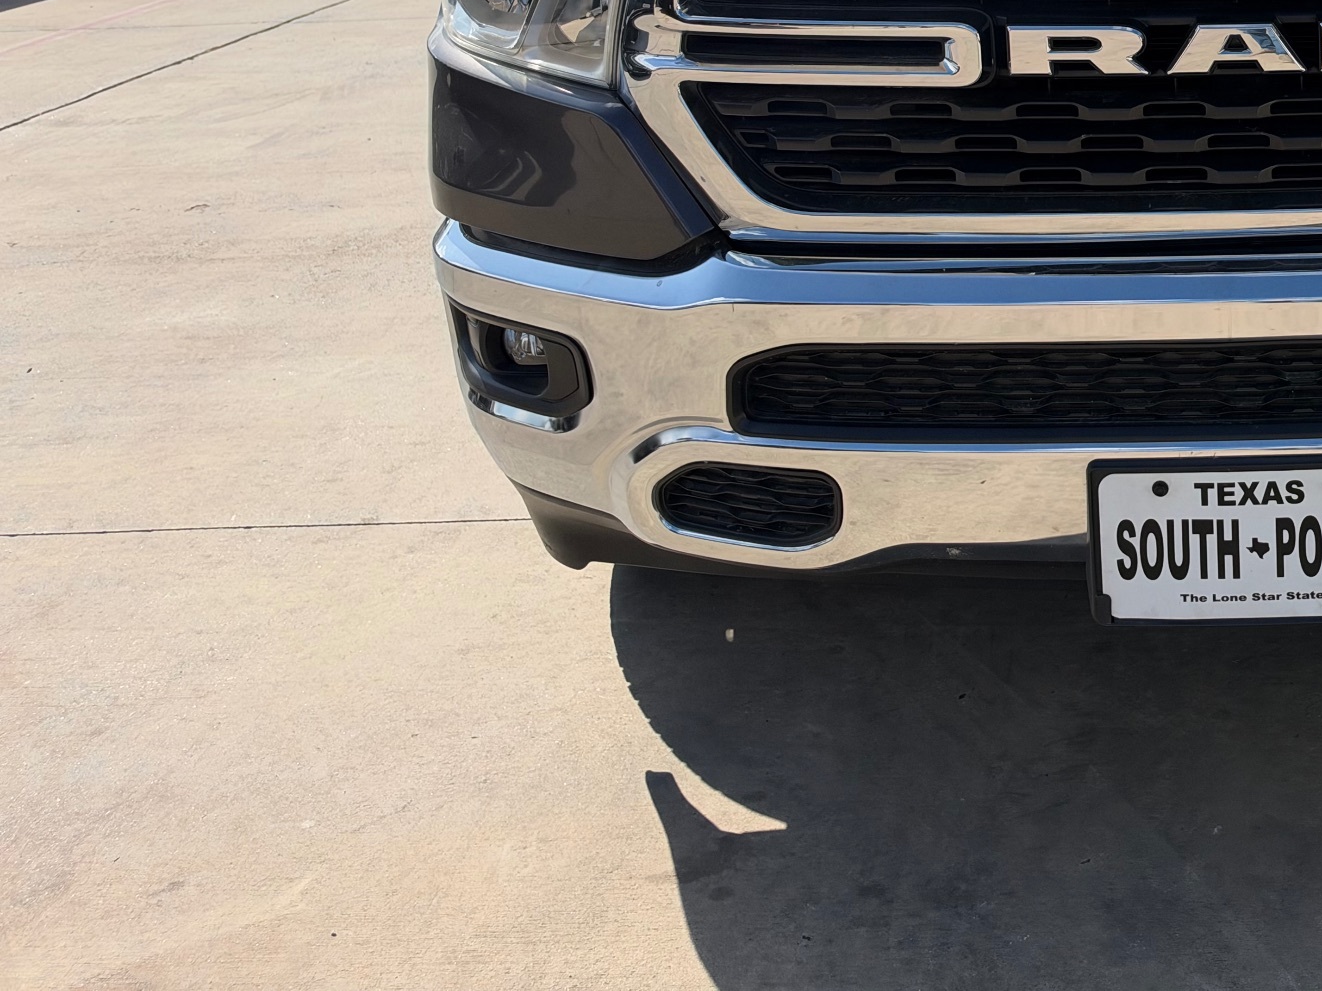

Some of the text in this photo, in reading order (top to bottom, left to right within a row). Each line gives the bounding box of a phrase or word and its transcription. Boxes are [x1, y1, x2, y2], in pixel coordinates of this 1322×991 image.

[1194, 480, 1305, 506] TEXAS
[1116, 518, 1241, 580] SOUTH
[1180, 593, 1208, 603] The
[1212, 593, 1247, 602] Lone
[1251, 592, 1282, 601] Star
